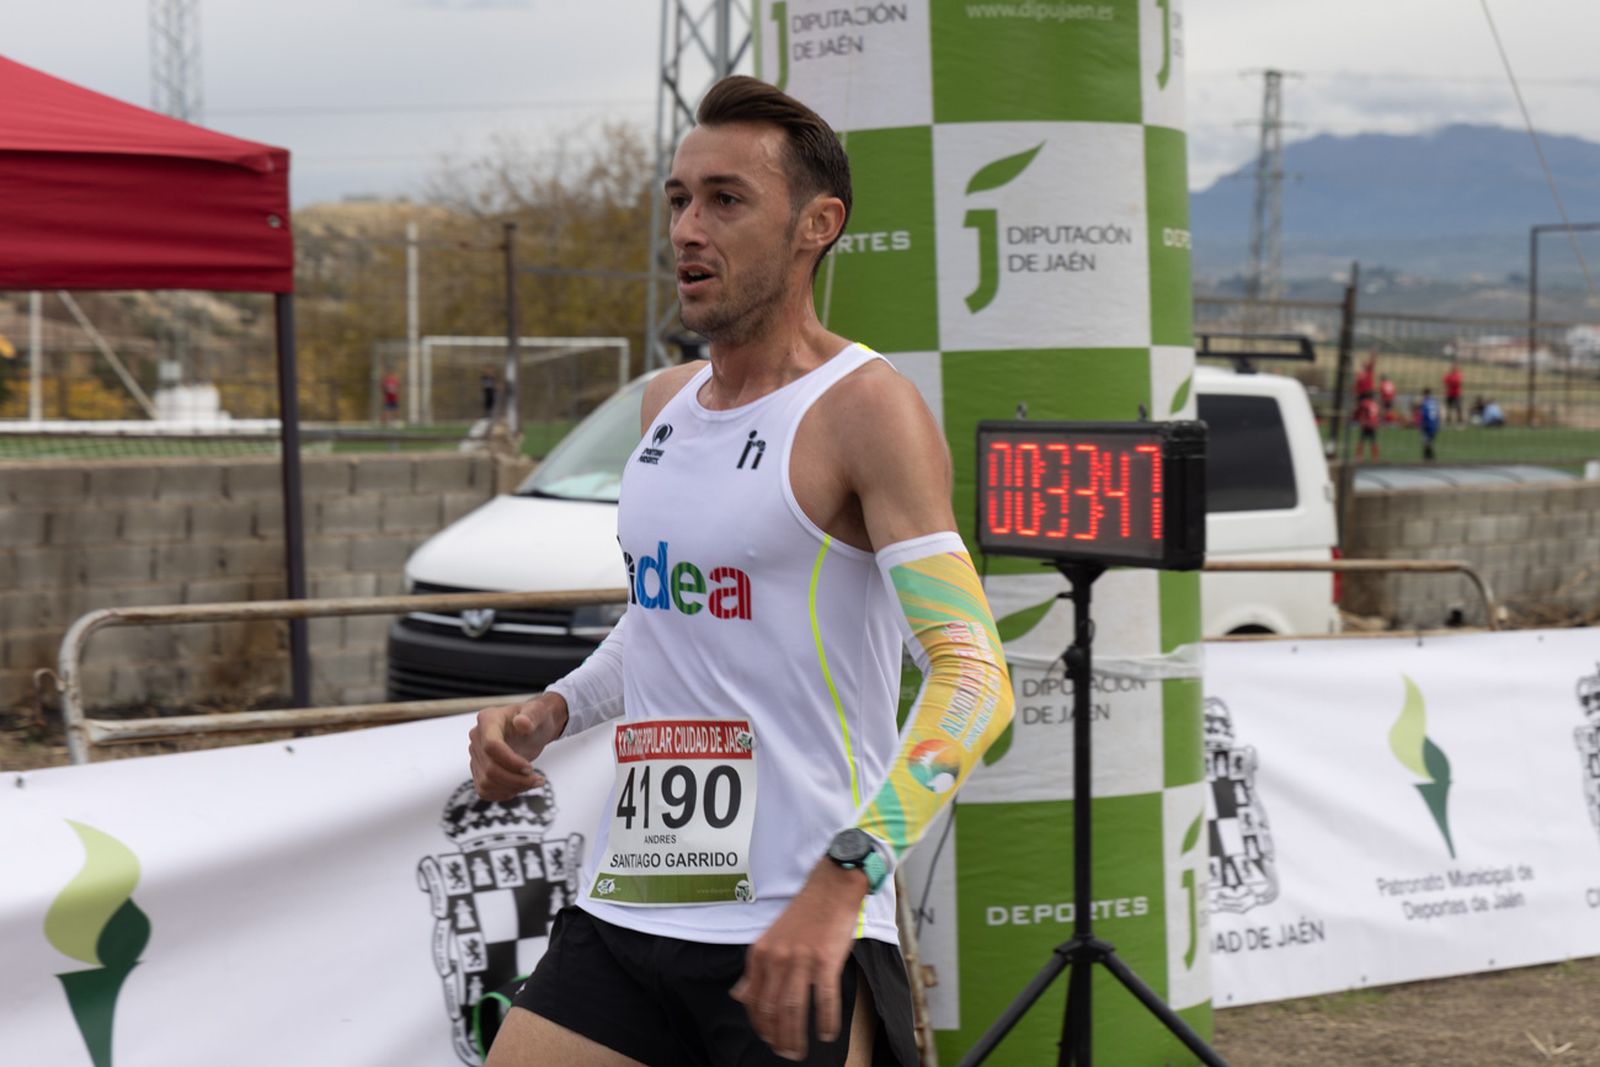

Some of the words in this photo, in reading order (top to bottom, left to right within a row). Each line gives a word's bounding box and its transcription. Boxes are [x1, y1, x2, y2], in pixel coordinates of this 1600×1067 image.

[792, 2, 908, 33] DIPUTACIÓN
[793, 40, 816, 61] DE
[814, 35, 864, 58] JAÉN
[1006, 223, 1132, 246] DIPUTACIÓN
[1008, 254, 1038, 272] DE
[1043, 252, 1096, 272] JAÉN
[1022, 706, 1053, 725] DE
[674, 726, 709, 754] CIUDAD
[709, 726, 723, 753] DE
[616, 765, 742, 830] 4190
[644, 834, 677, 845] ANDRES
[610, 852, 661, 868] SANTIAGO
[665, 851, 738, 868] GARRIDO
[1246, 926, 1272, 951] DE
[1276, 916, 1326, 948] JAÉN
